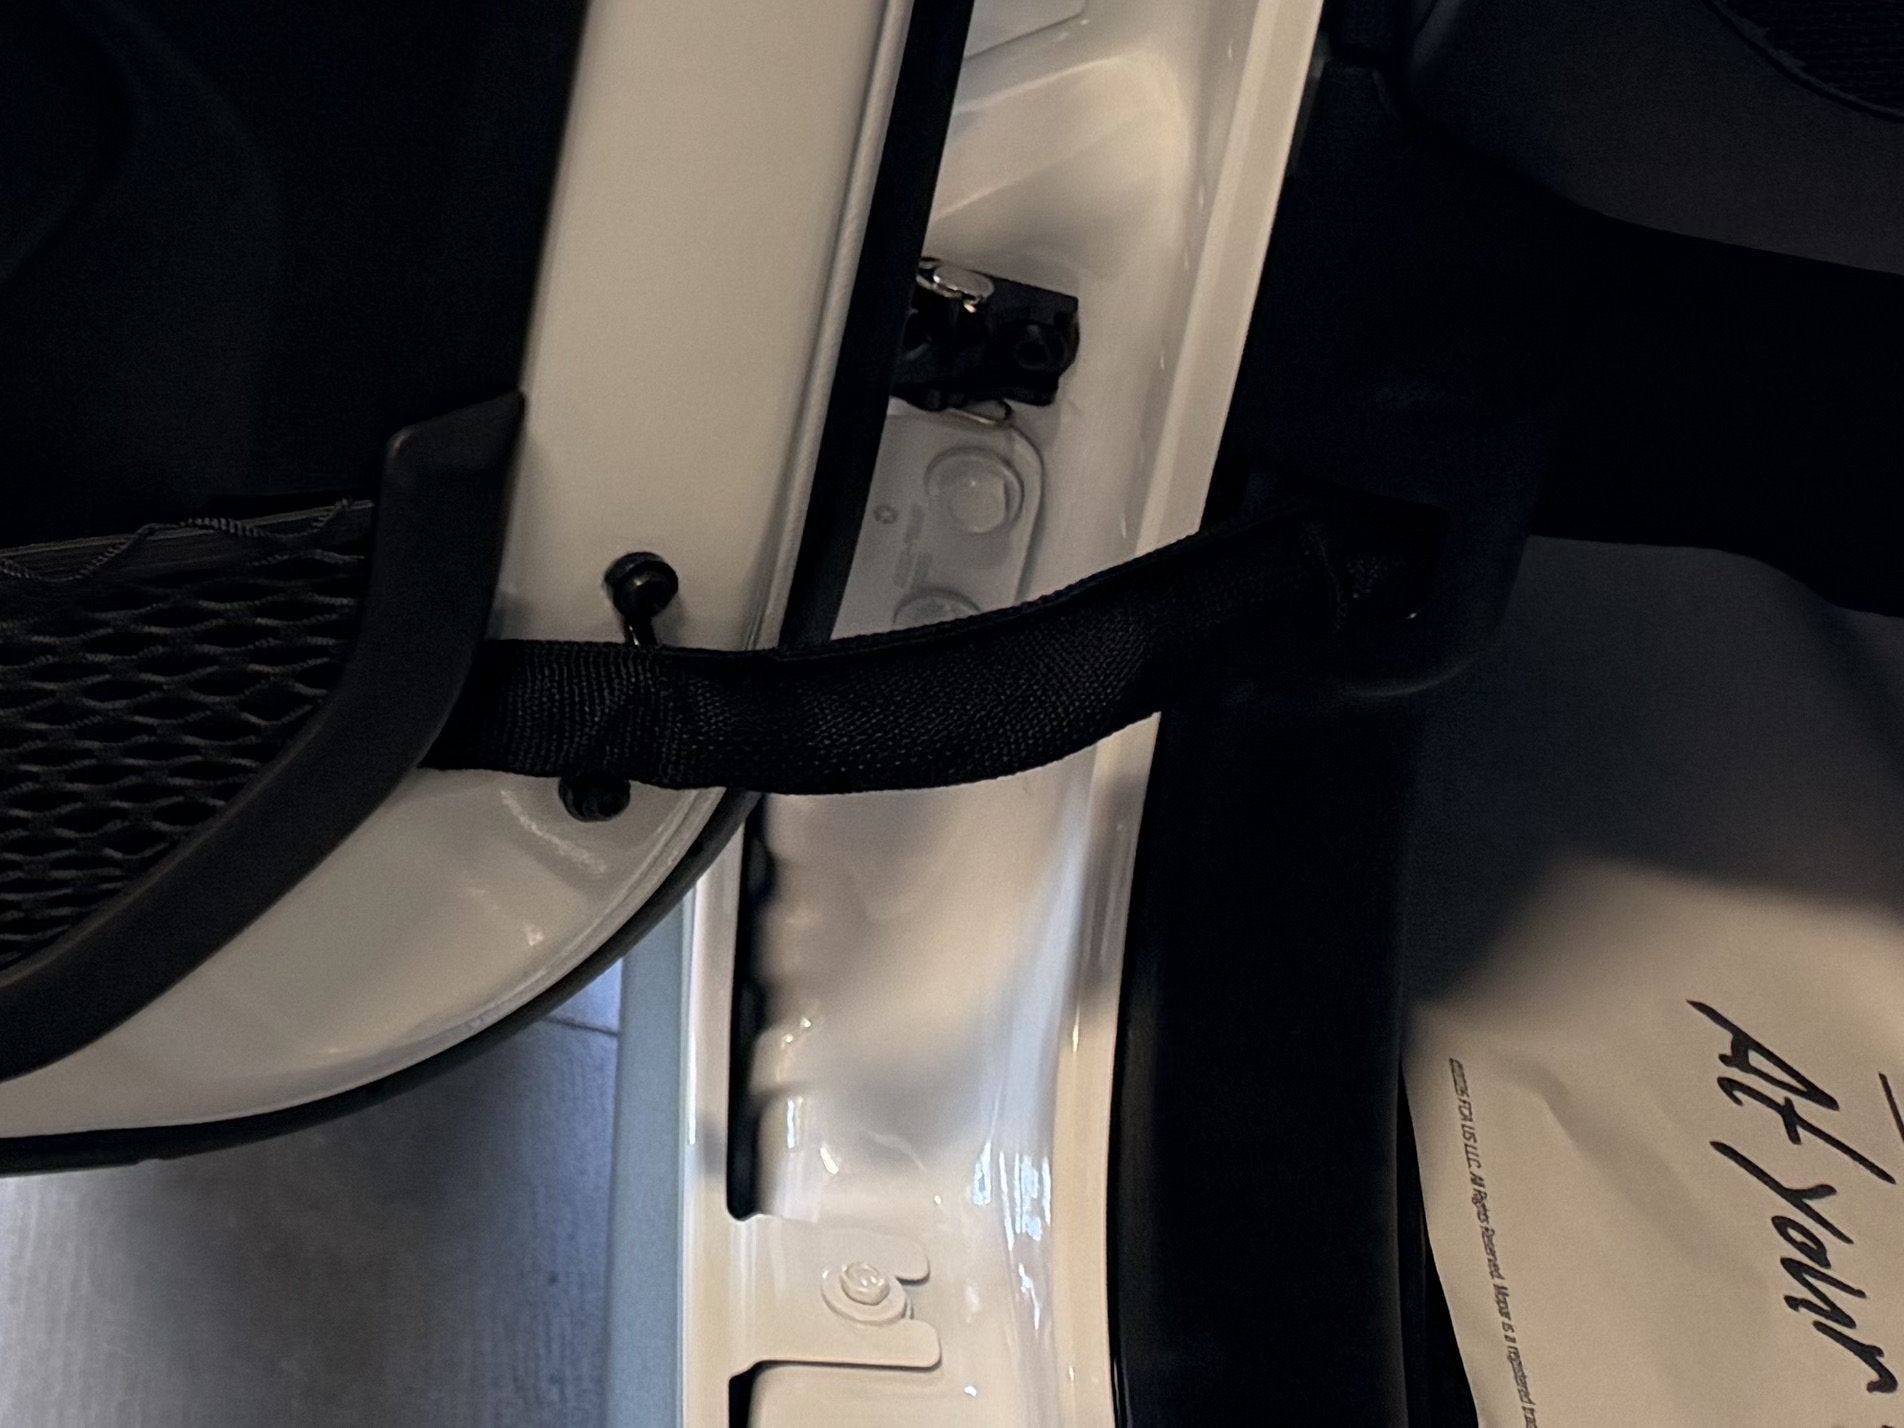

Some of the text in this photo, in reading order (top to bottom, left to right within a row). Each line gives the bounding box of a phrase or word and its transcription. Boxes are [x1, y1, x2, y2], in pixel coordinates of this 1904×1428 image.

[1457, 1097, 1474, 1123] FCA
[1460, 1123, 1478, 1143] US
[1685, 998, 1898, 1394] At Your
